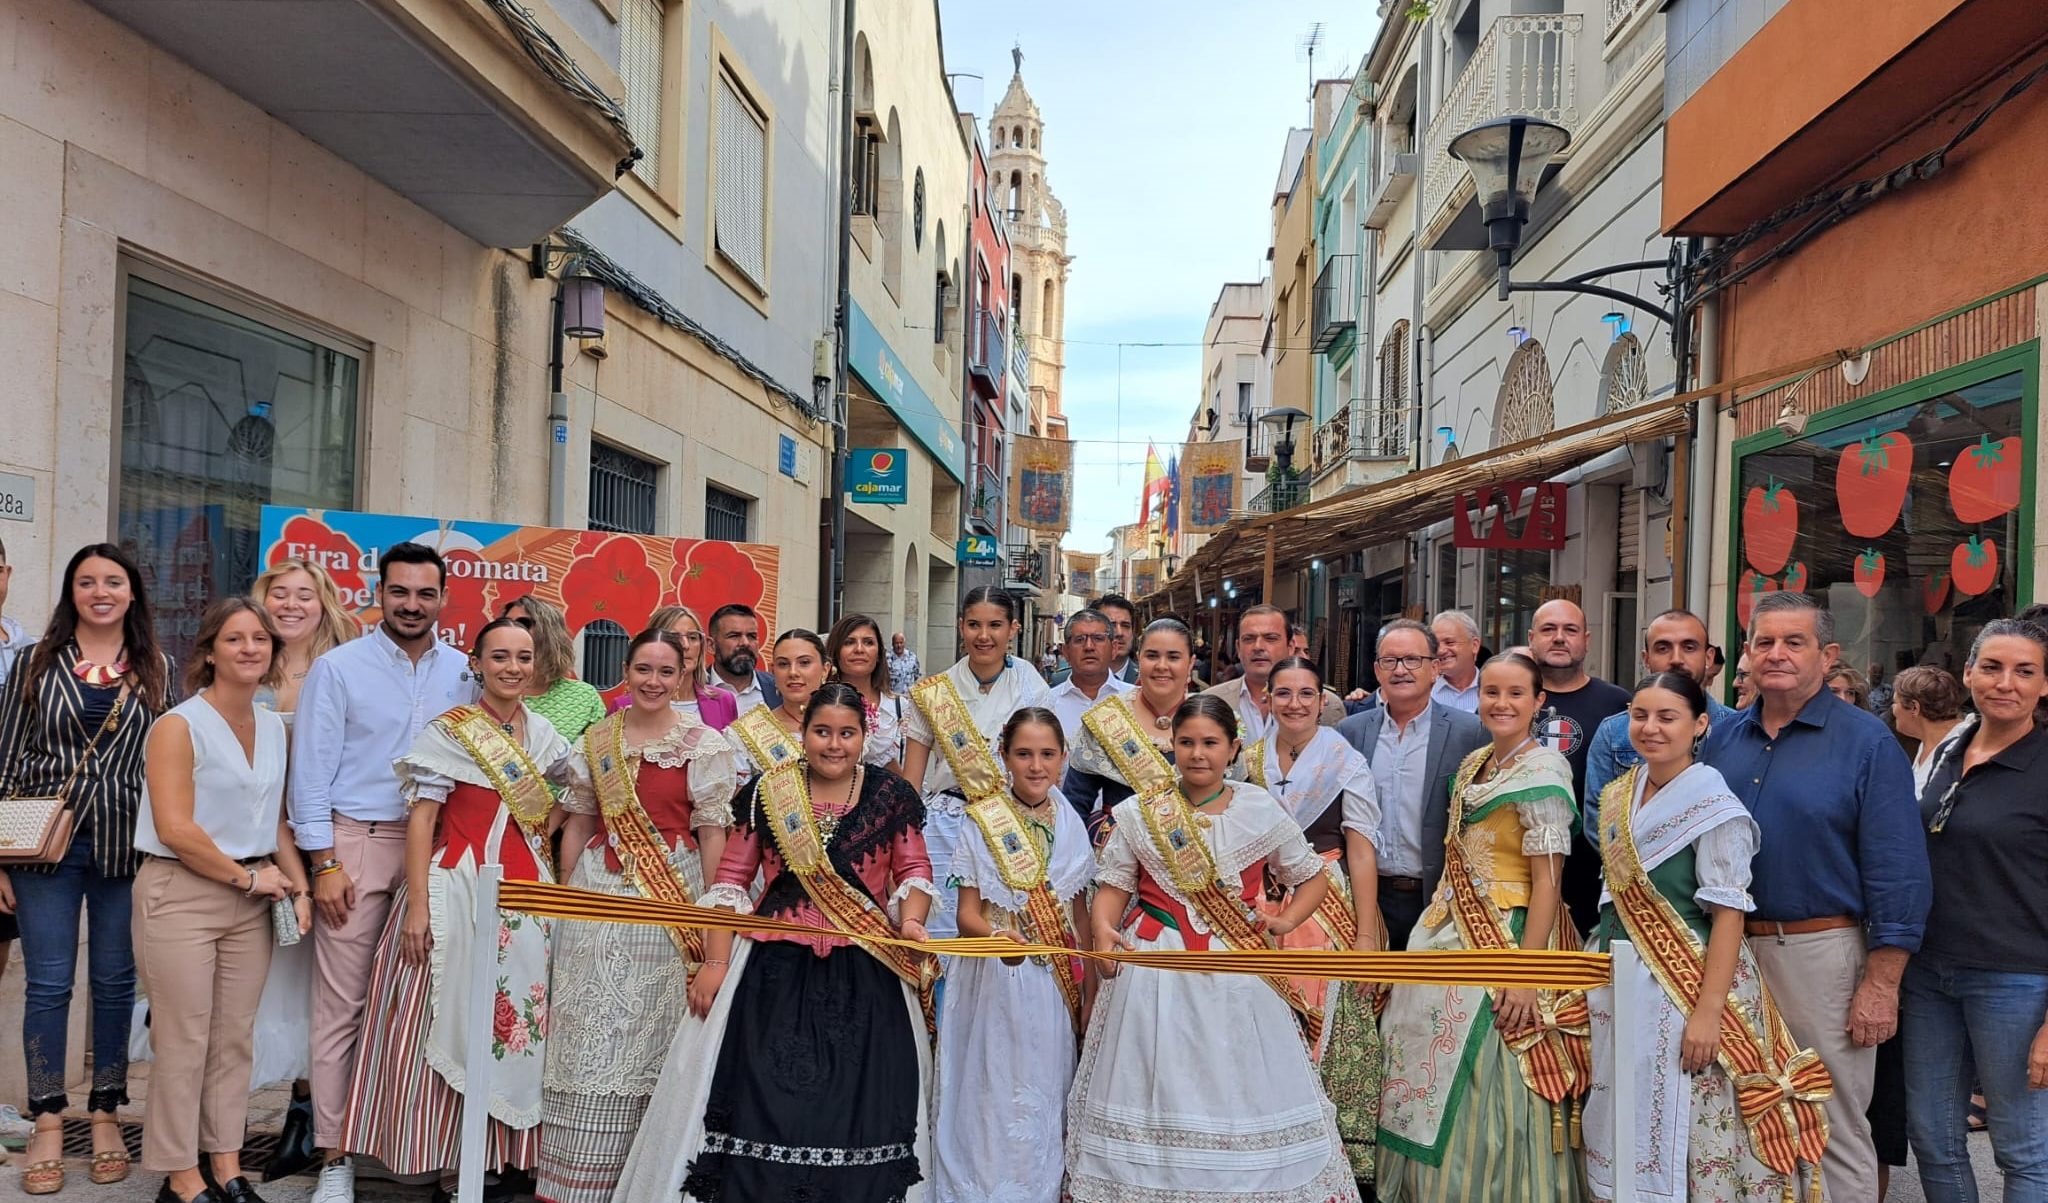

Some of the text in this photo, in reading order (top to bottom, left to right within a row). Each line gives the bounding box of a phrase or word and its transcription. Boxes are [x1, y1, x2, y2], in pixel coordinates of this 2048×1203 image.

[855, 481, 902, 495] cajamar
[967, 536, 995, 557] 24h
[287, 543, 350, 571] Fira
[445, 555, 548, 582] tomata
